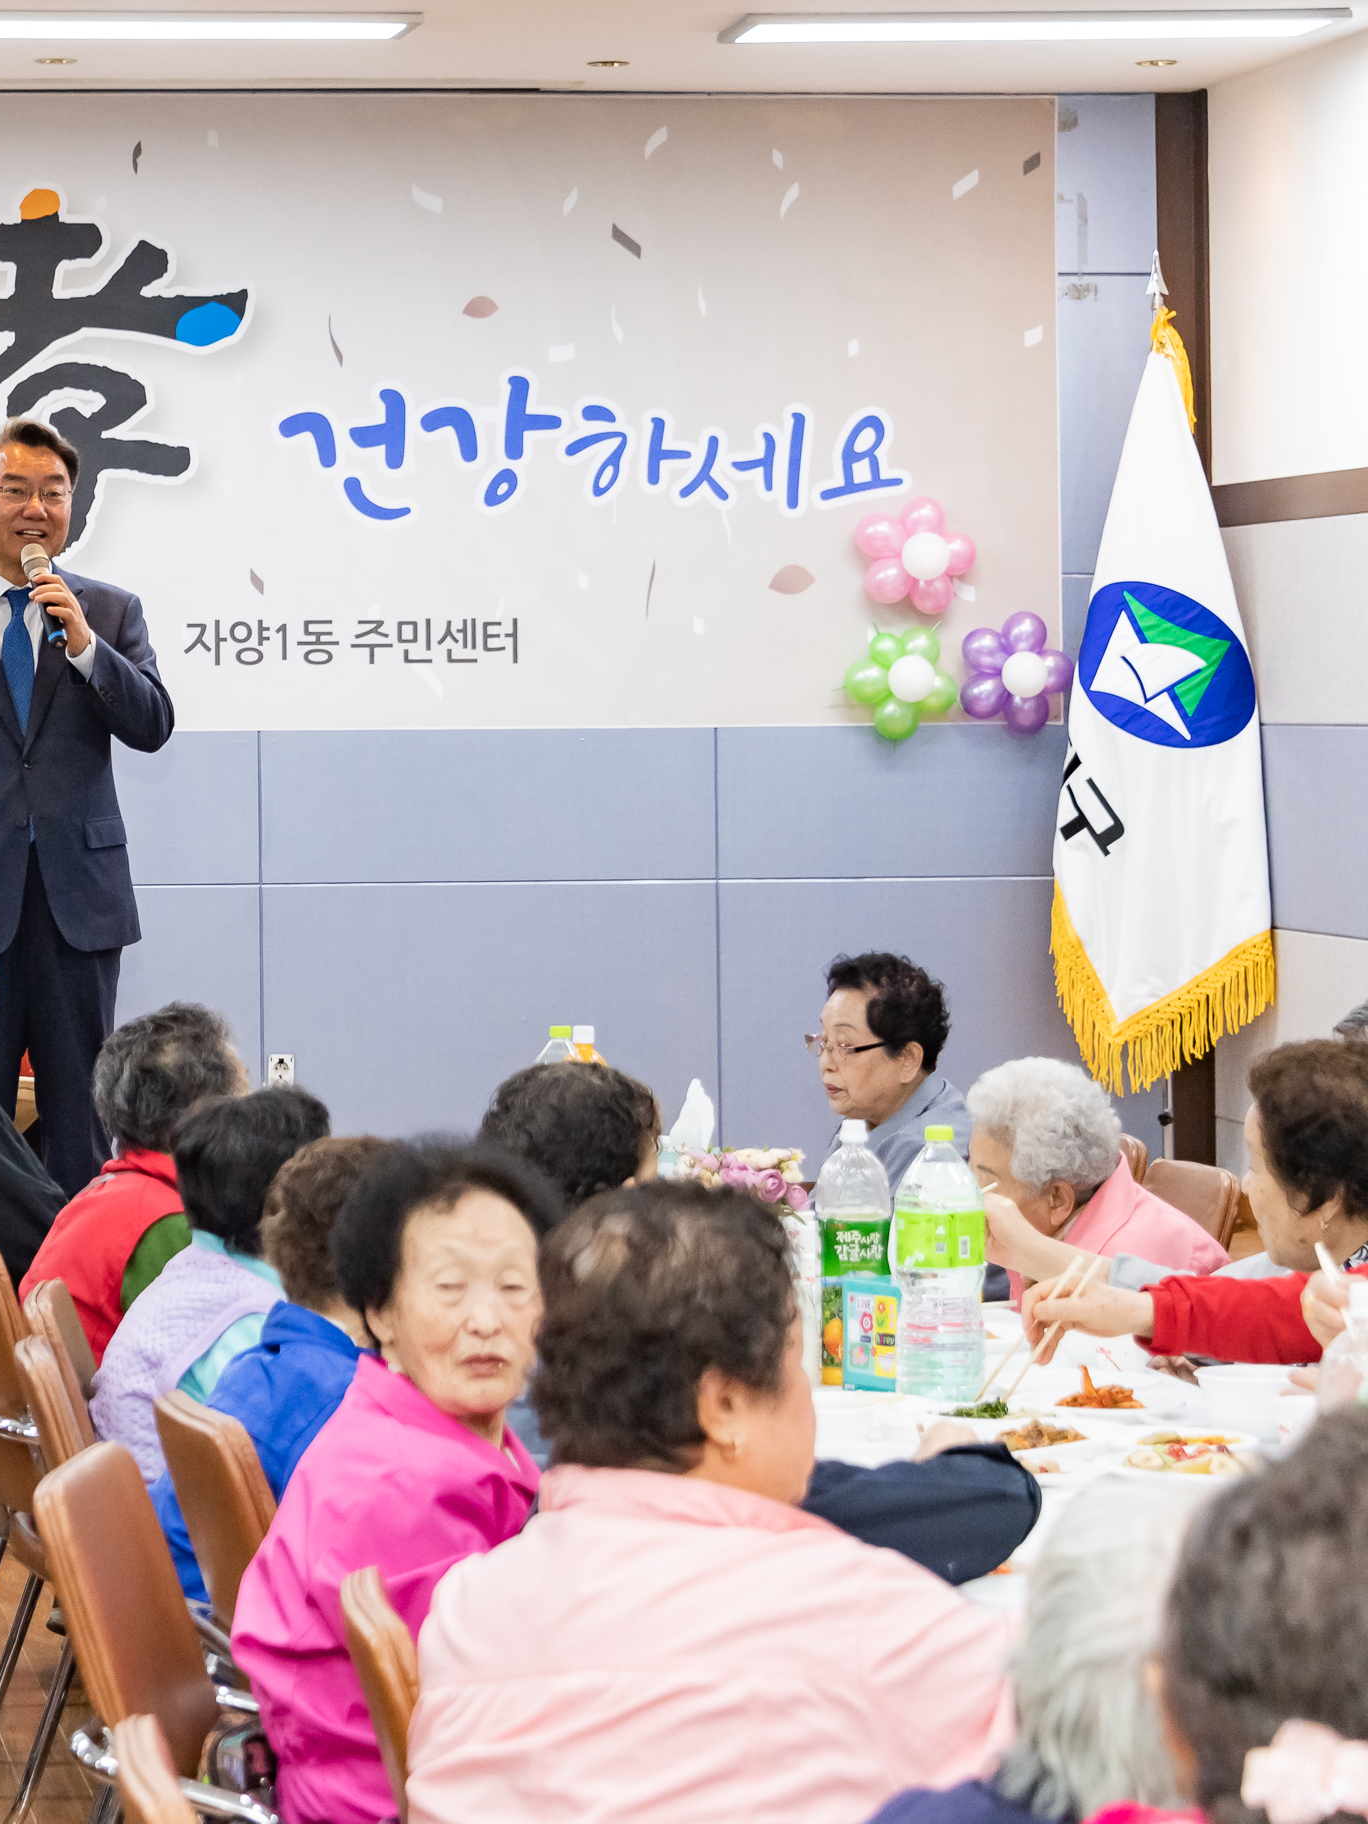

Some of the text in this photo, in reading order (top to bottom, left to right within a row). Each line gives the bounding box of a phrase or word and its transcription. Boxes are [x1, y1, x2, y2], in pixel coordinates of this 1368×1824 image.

[278, 375, 904, 521] 건강하세요
[183, 618, 340, 667] 자양1동
[350, 616, 520, 666] 주민센터
[835, 1229, 881, 1245] 제주사랑
[856, 1297, 871, 1311] LOVE
